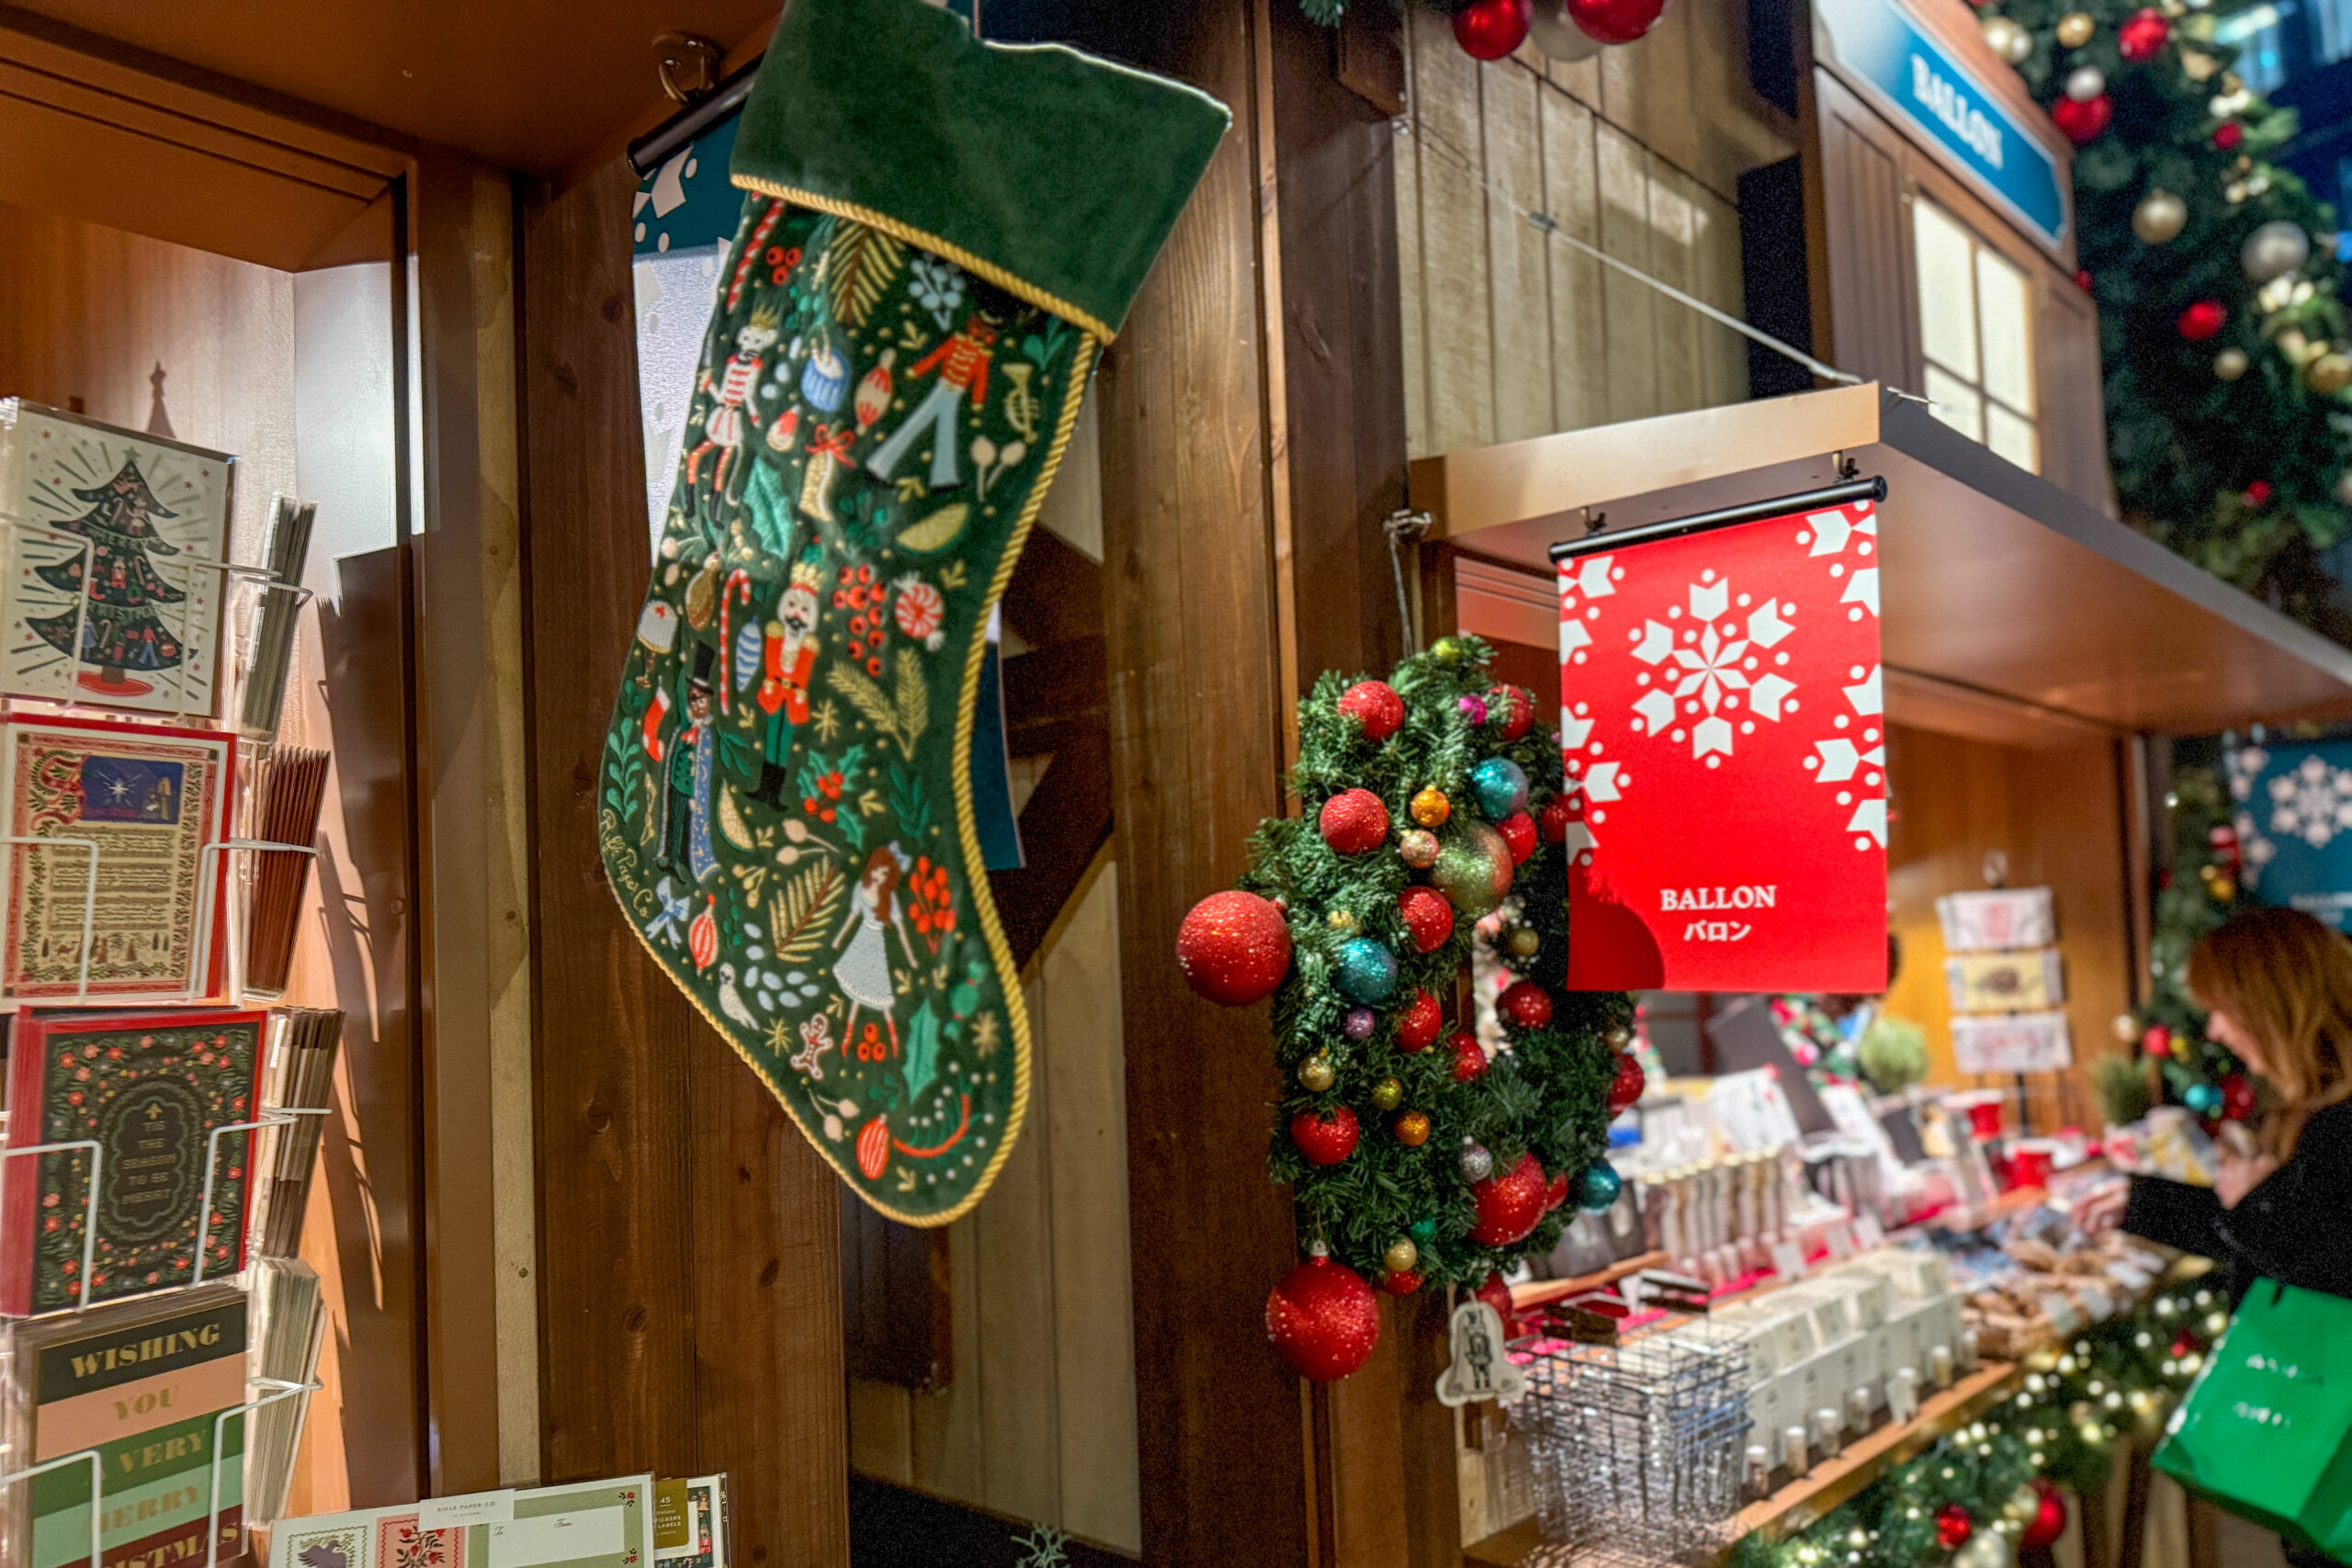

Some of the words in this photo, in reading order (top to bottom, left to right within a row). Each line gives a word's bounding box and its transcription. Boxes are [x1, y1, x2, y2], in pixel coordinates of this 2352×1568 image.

[1911, 53, 2003, 171] BALLON
[617, 848, 639, 893] Paper
[1659, 885, 1777, 911] BALLON
[1682, 919, 1752, 942] バロン
[71, 1323, 220, 1378] WISHING
[112, 1385, 179, 1420] YOU
[119, 1429, 208, 1473] VERY
